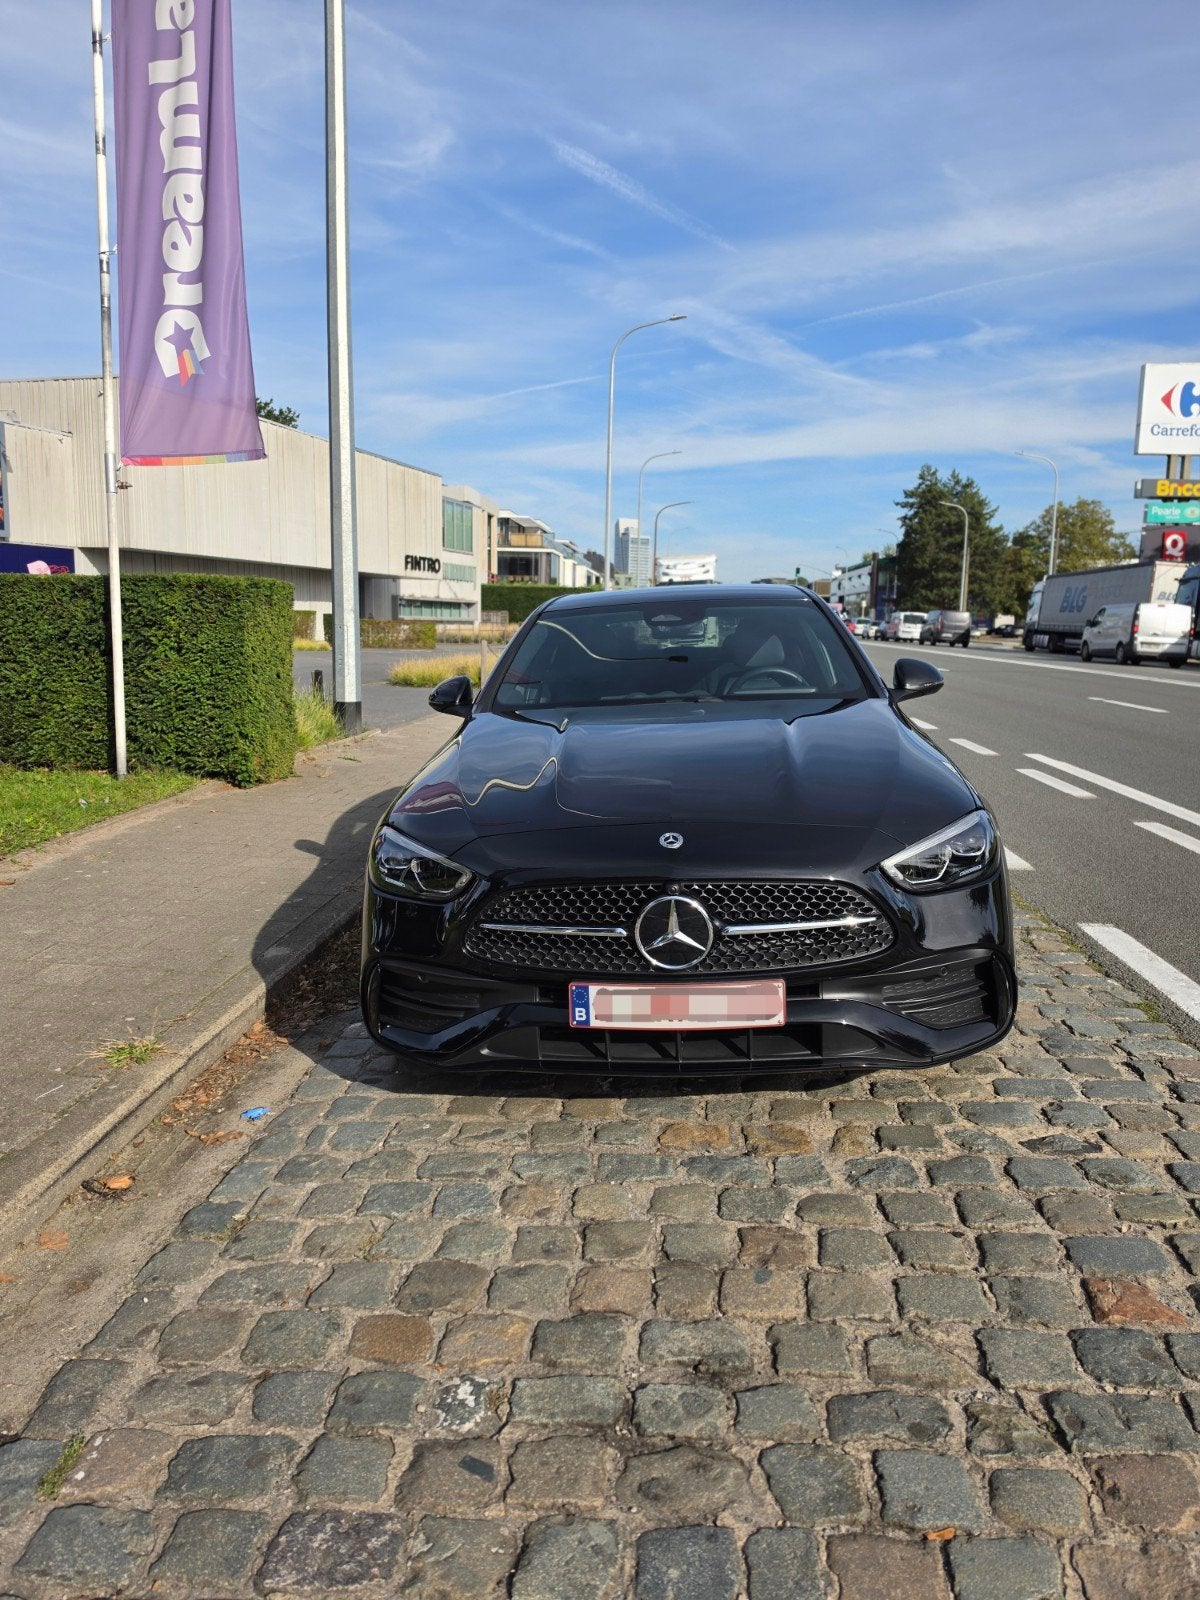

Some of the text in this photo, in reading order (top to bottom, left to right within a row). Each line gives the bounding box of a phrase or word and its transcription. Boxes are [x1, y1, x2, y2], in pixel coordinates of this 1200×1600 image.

[1151, 506, 1181, 516] Pearle
[405, 555, 441, 574] FINTRO
[1059, 585, 1088, 613] BLG
[575, 1008, 586, 1020] B
